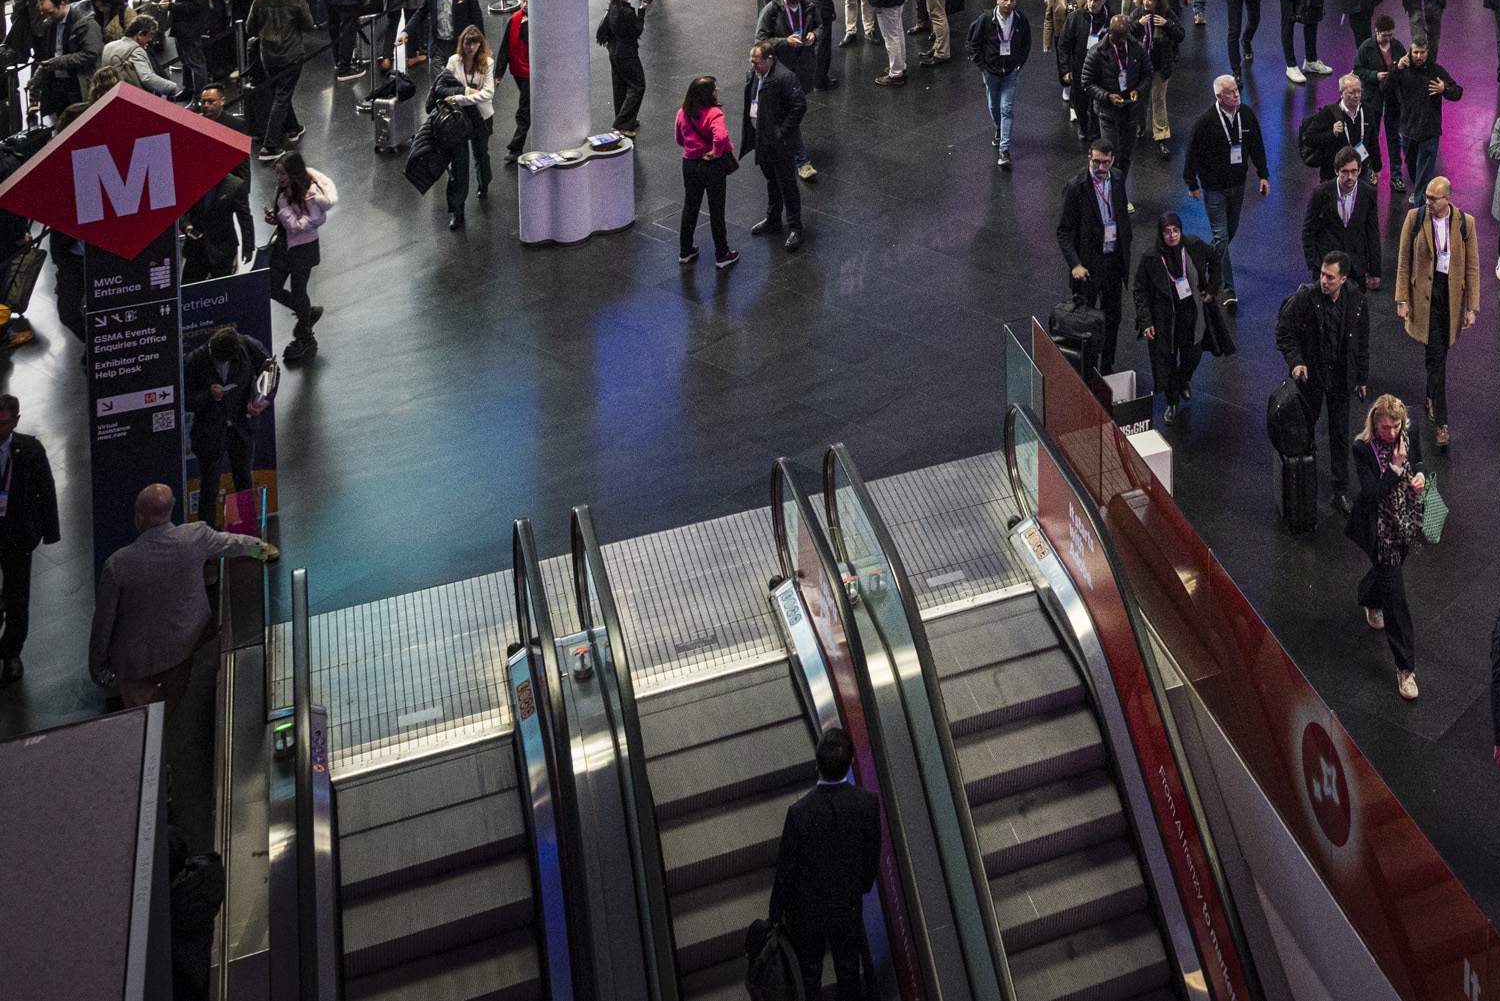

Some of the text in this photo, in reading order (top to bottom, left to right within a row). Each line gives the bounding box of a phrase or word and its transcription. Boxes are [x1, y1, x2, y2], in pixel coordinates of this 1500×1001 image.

[71, 132, 177, 224] M
[94, 275, 123, 288] MWC
[94, 282, 142, 298] Entrance
[94, 326, 157, 344] GSMA Events
[94, 333, 167, 354] Enquiries Office
[95, 351, 160, 370] Exhibitor Care
[95, 364, 142, 380] Help Desk
